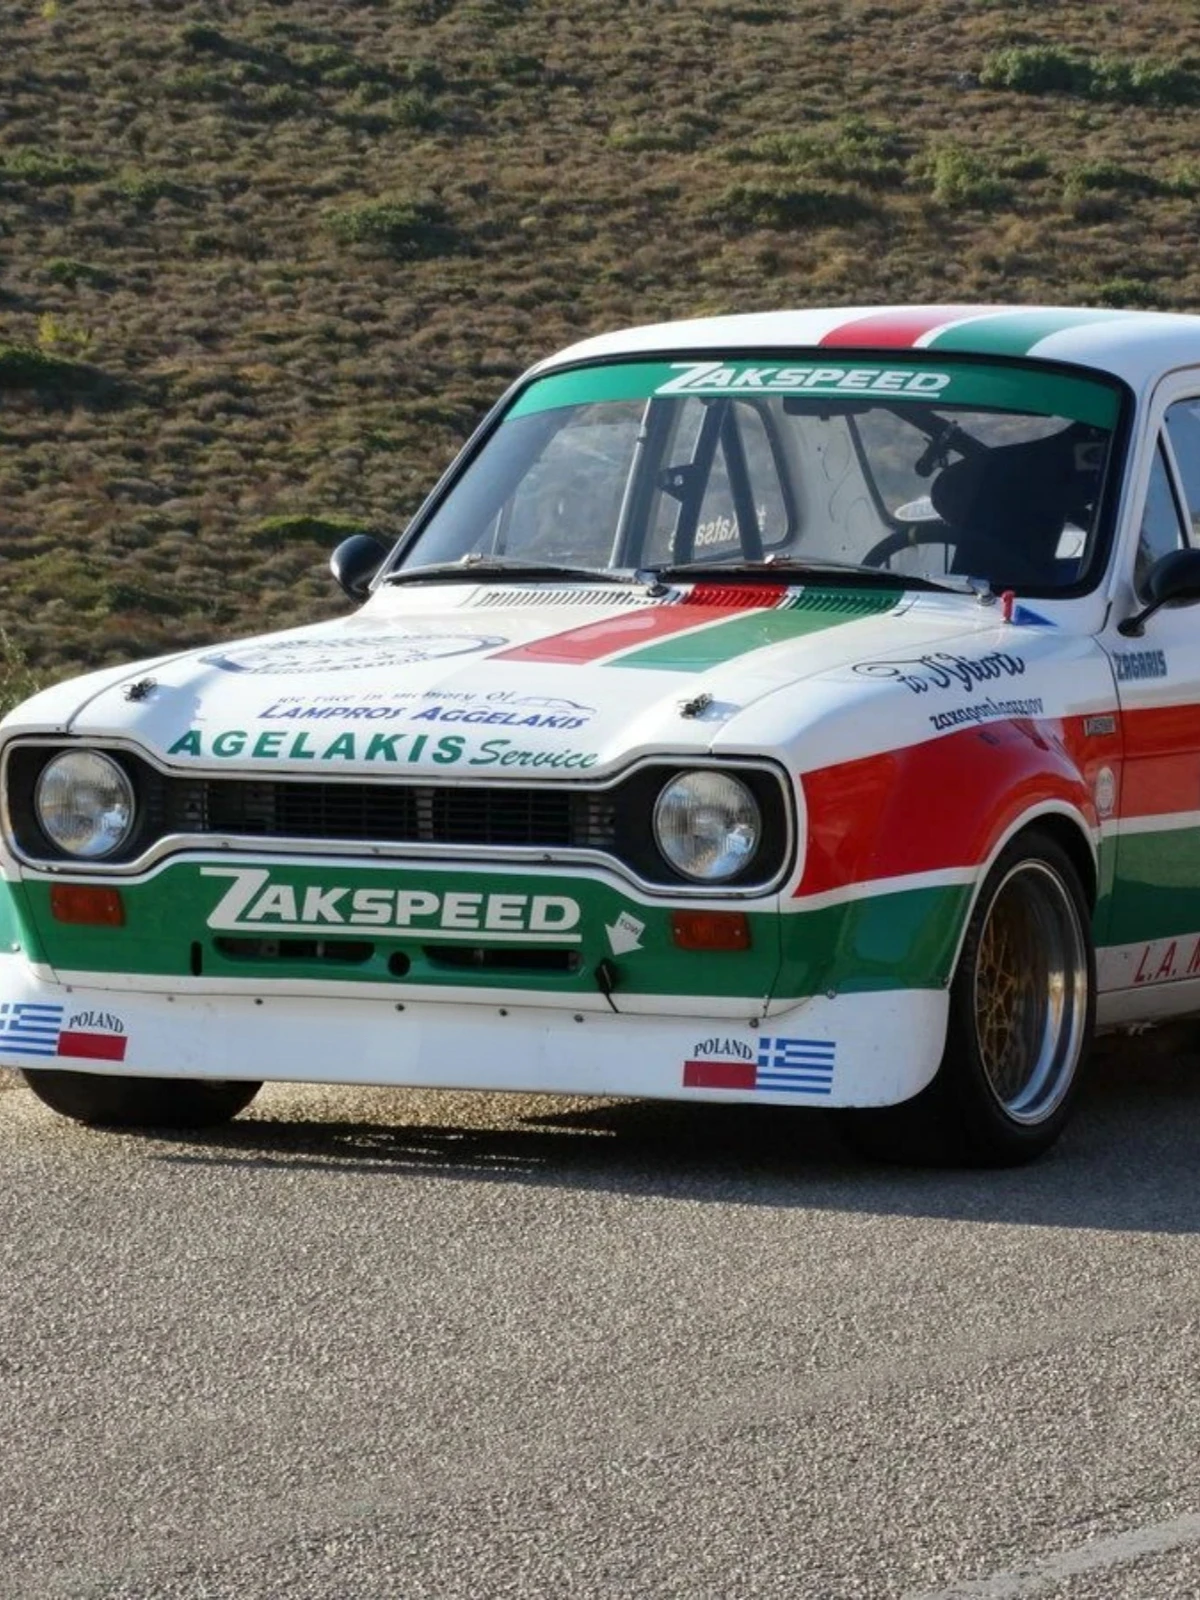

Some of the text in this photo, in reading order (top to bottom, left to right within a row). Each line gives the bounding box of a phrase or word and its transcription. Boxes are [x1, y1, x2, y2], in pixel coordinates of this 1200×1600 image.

[655, 362, 951, 398] ZAKSPEED
[1112, 650, 1167, 681] ZAGARIS
[257, 704, 590, 730] LAMPROS AGGELAKIS
[167, 731, 600, 769] AGELAKIS Service
[200, 867, 582, 943] ZAKSPEED
[620, 918, 640, 936] TOW
[69, 1011, 124, 1033] POLAND
[694, 1038, 752, 1060] POLAND
